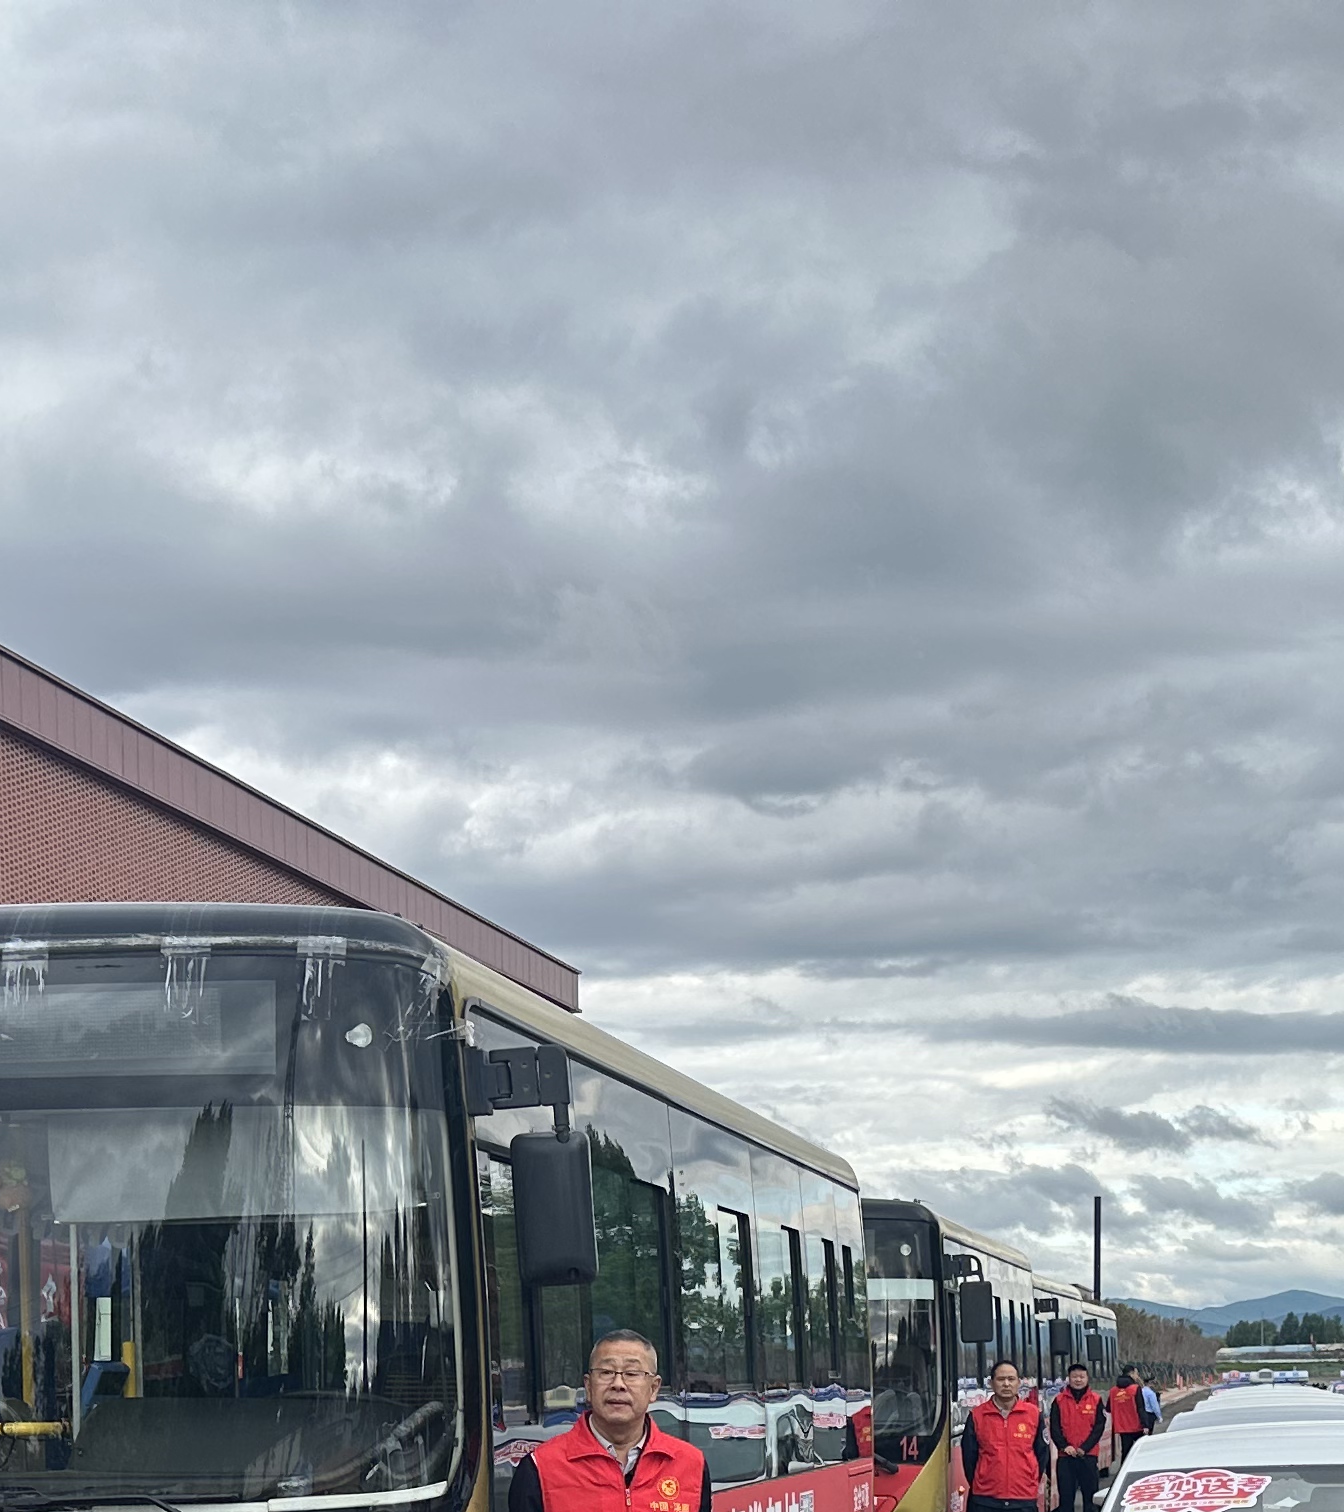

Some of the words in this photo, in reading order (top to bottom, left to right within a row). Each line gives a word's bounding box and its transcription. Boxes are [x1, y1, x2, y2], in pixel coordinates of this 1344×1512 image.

[899, 1435, 920, 1461] 14
[1126, 1476, 1268, 1506] 爱心送考
